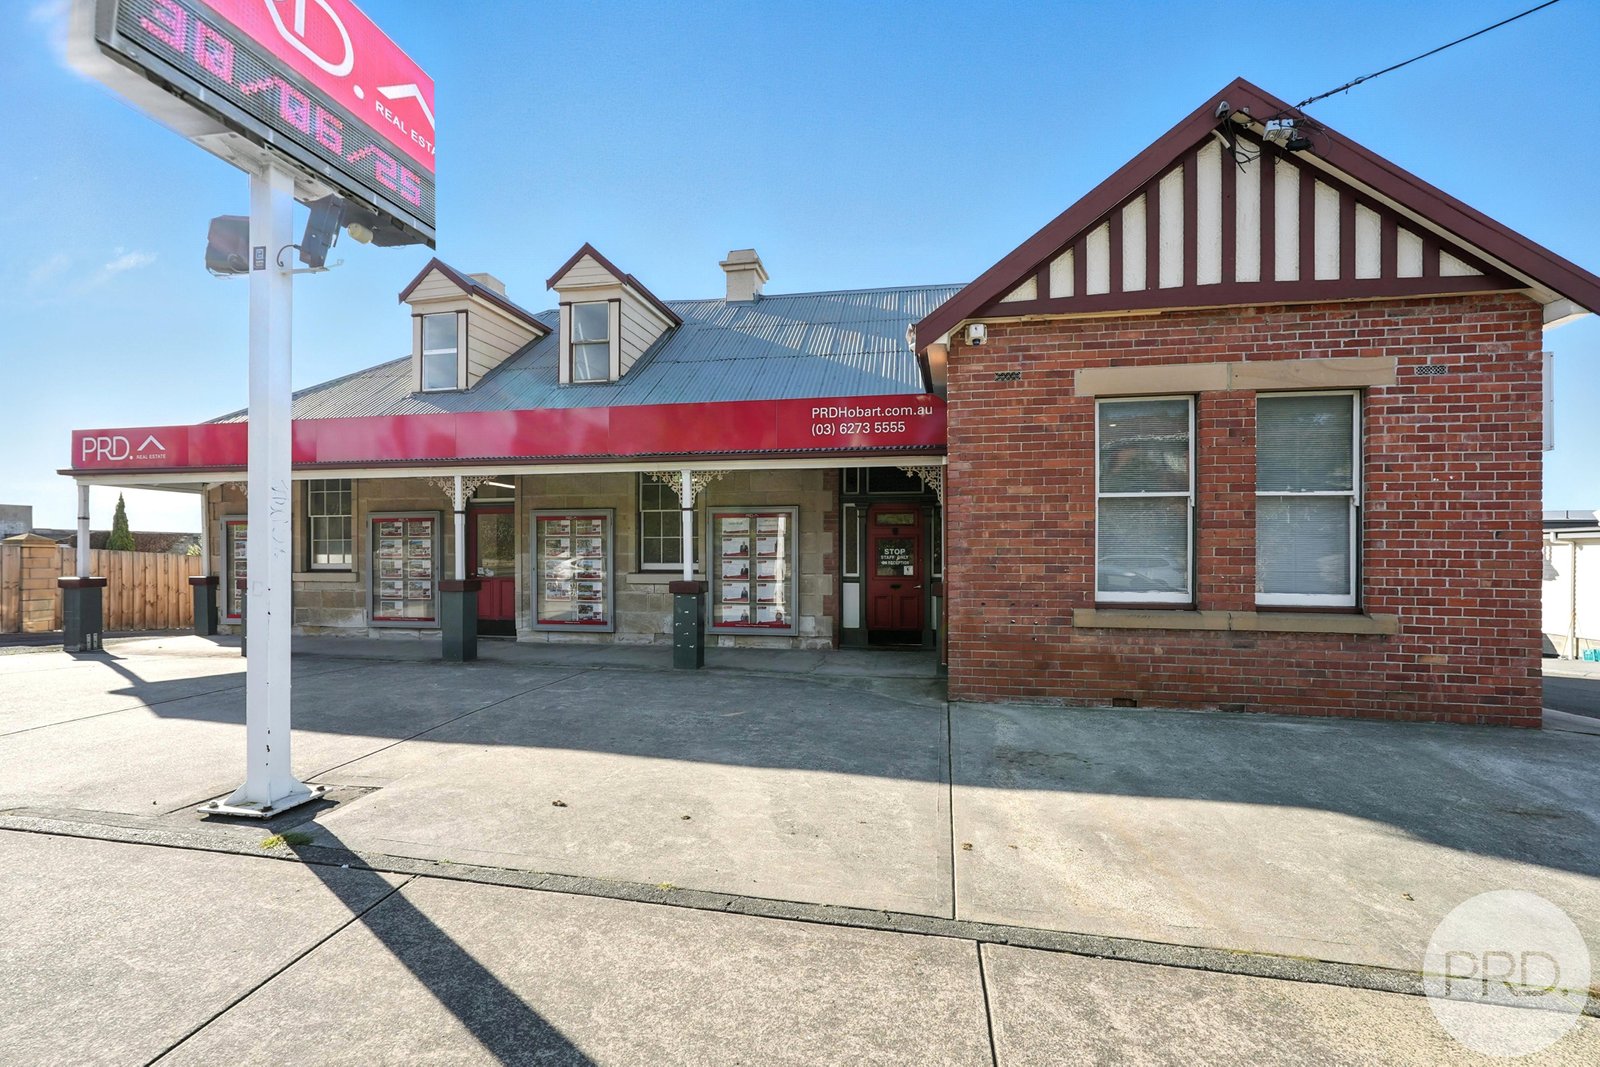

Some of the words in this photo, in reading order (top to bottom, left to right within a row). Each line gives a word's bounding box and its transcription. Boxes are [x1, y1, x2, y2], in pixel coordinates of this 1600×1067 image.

[375, 100, 408, 135] REAL
[811, 405, 933, 419] PRDHobart.com.au
[811, 422, 835, 436] (03)
[839, 422, 870, 435] 6273
[874, 421, 906, 433] 5555
